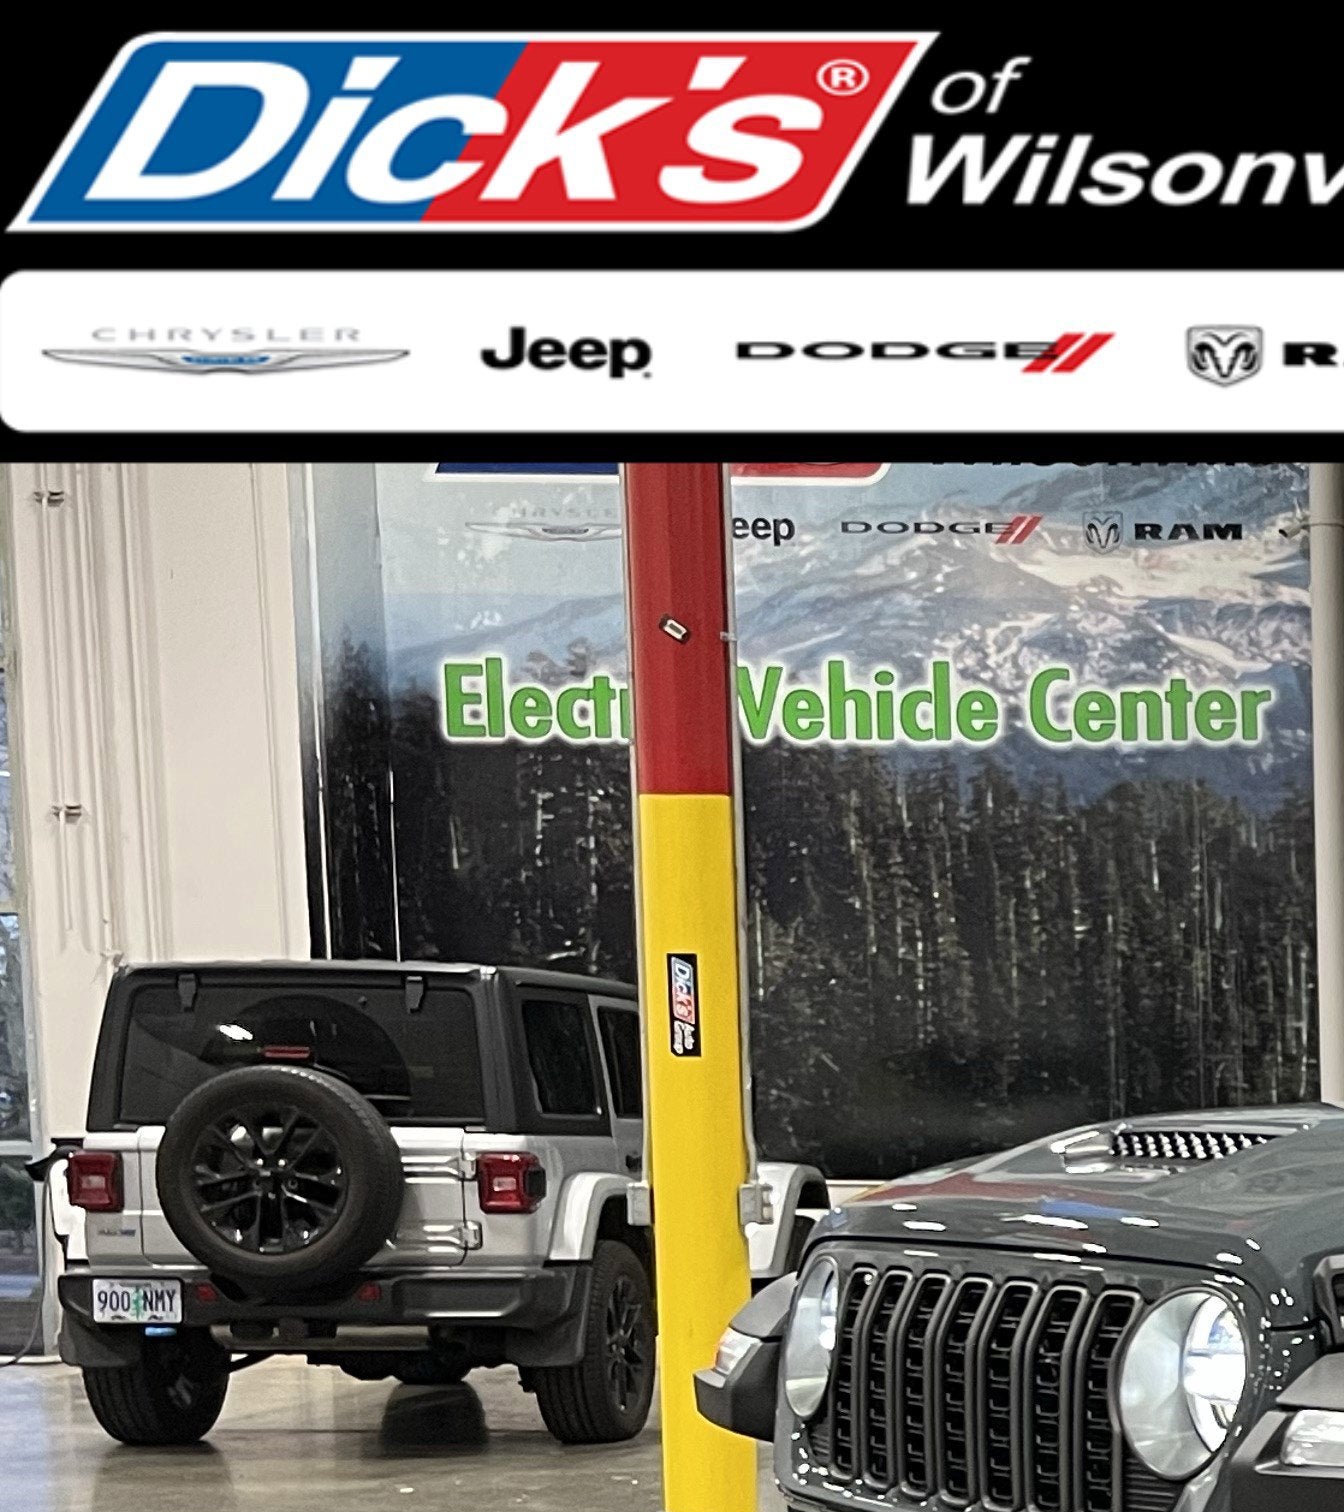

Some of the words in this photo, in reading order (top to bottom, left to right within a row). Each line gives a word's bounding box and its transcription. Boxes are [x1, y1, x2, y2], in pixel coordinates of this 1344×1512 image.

[732, 516, 796, 547] eep
[840, 519, 1013, 535] DODGE
[1133, 522, 1243, 541] RAM
[737, 660, 999, 742] Vehicle
[1029, 667, 1272, 743] Center
[97, 1290, 131, 1312] 900
